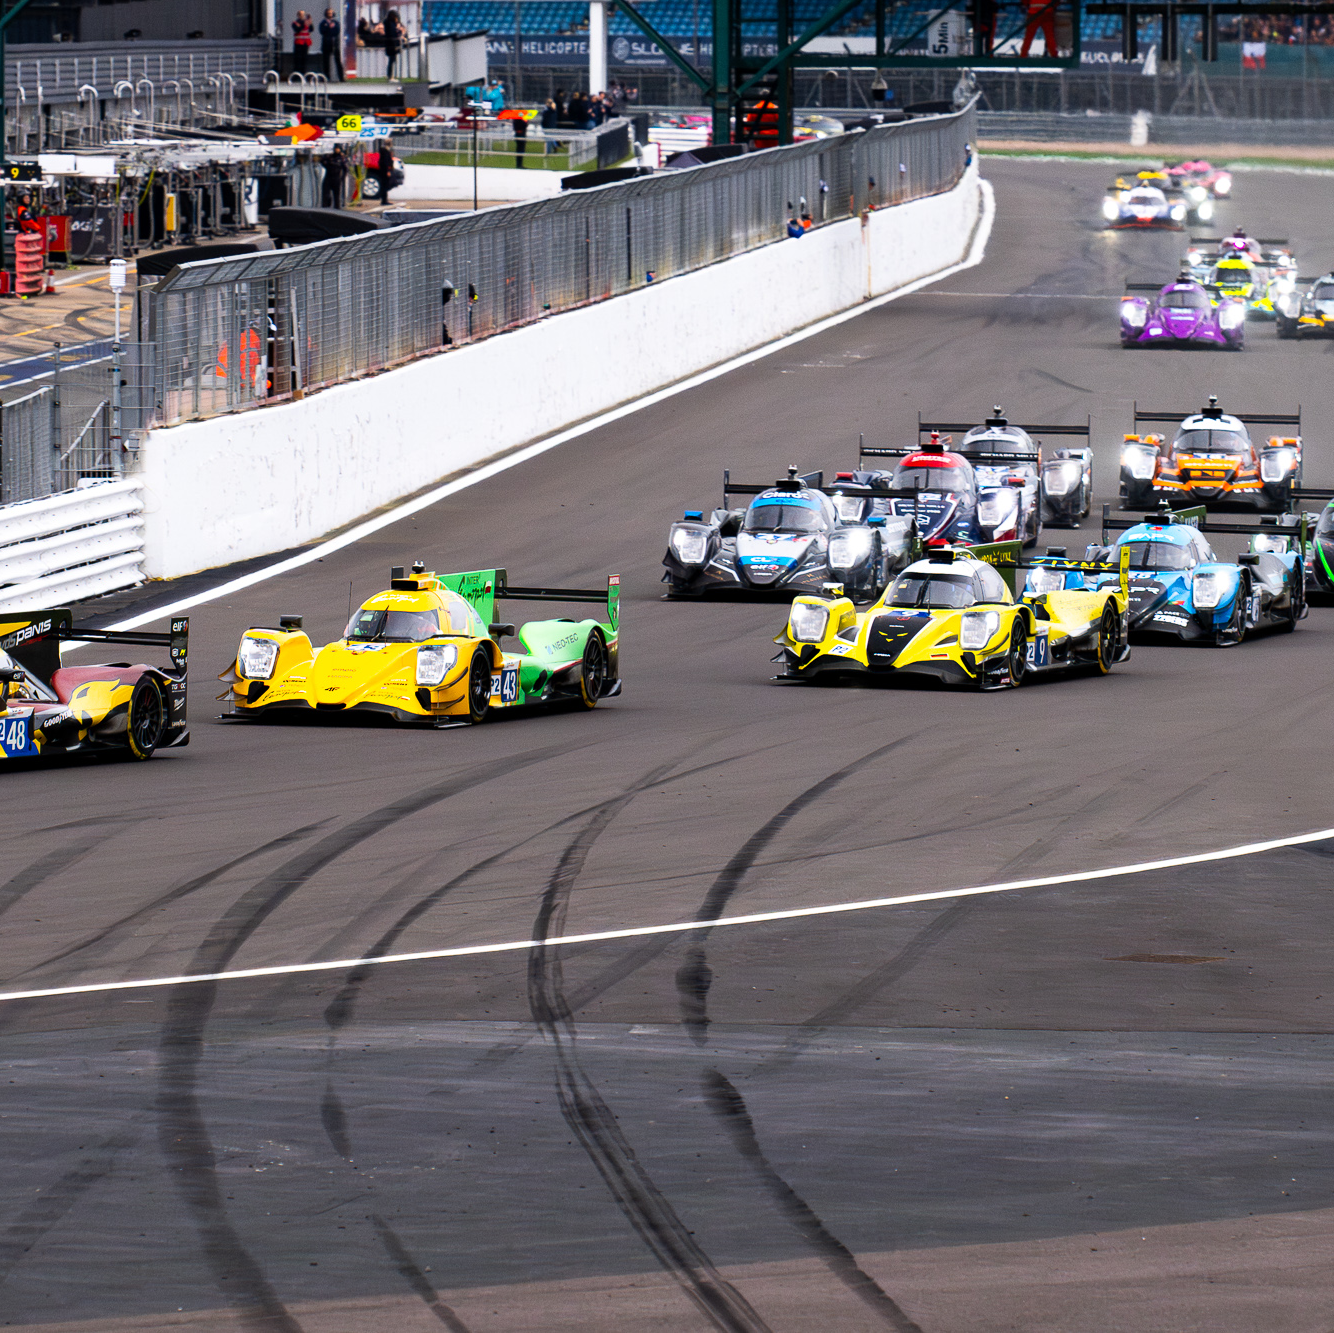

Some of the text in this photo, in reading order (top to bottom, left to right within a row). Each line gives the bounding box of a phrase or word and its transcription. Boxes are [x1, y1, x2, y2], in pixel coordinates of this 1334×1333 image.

[341, 118, 357, 129] 66
[11, 168, 19, 179] 9
[173, 621, 184, 632] elf
[552, 632, 579, 653] NEO-TEC
[1040, 638, 1046, 664] 9
[503, 670, 516, 701] 43
[7, 720, 26, 751] 48
